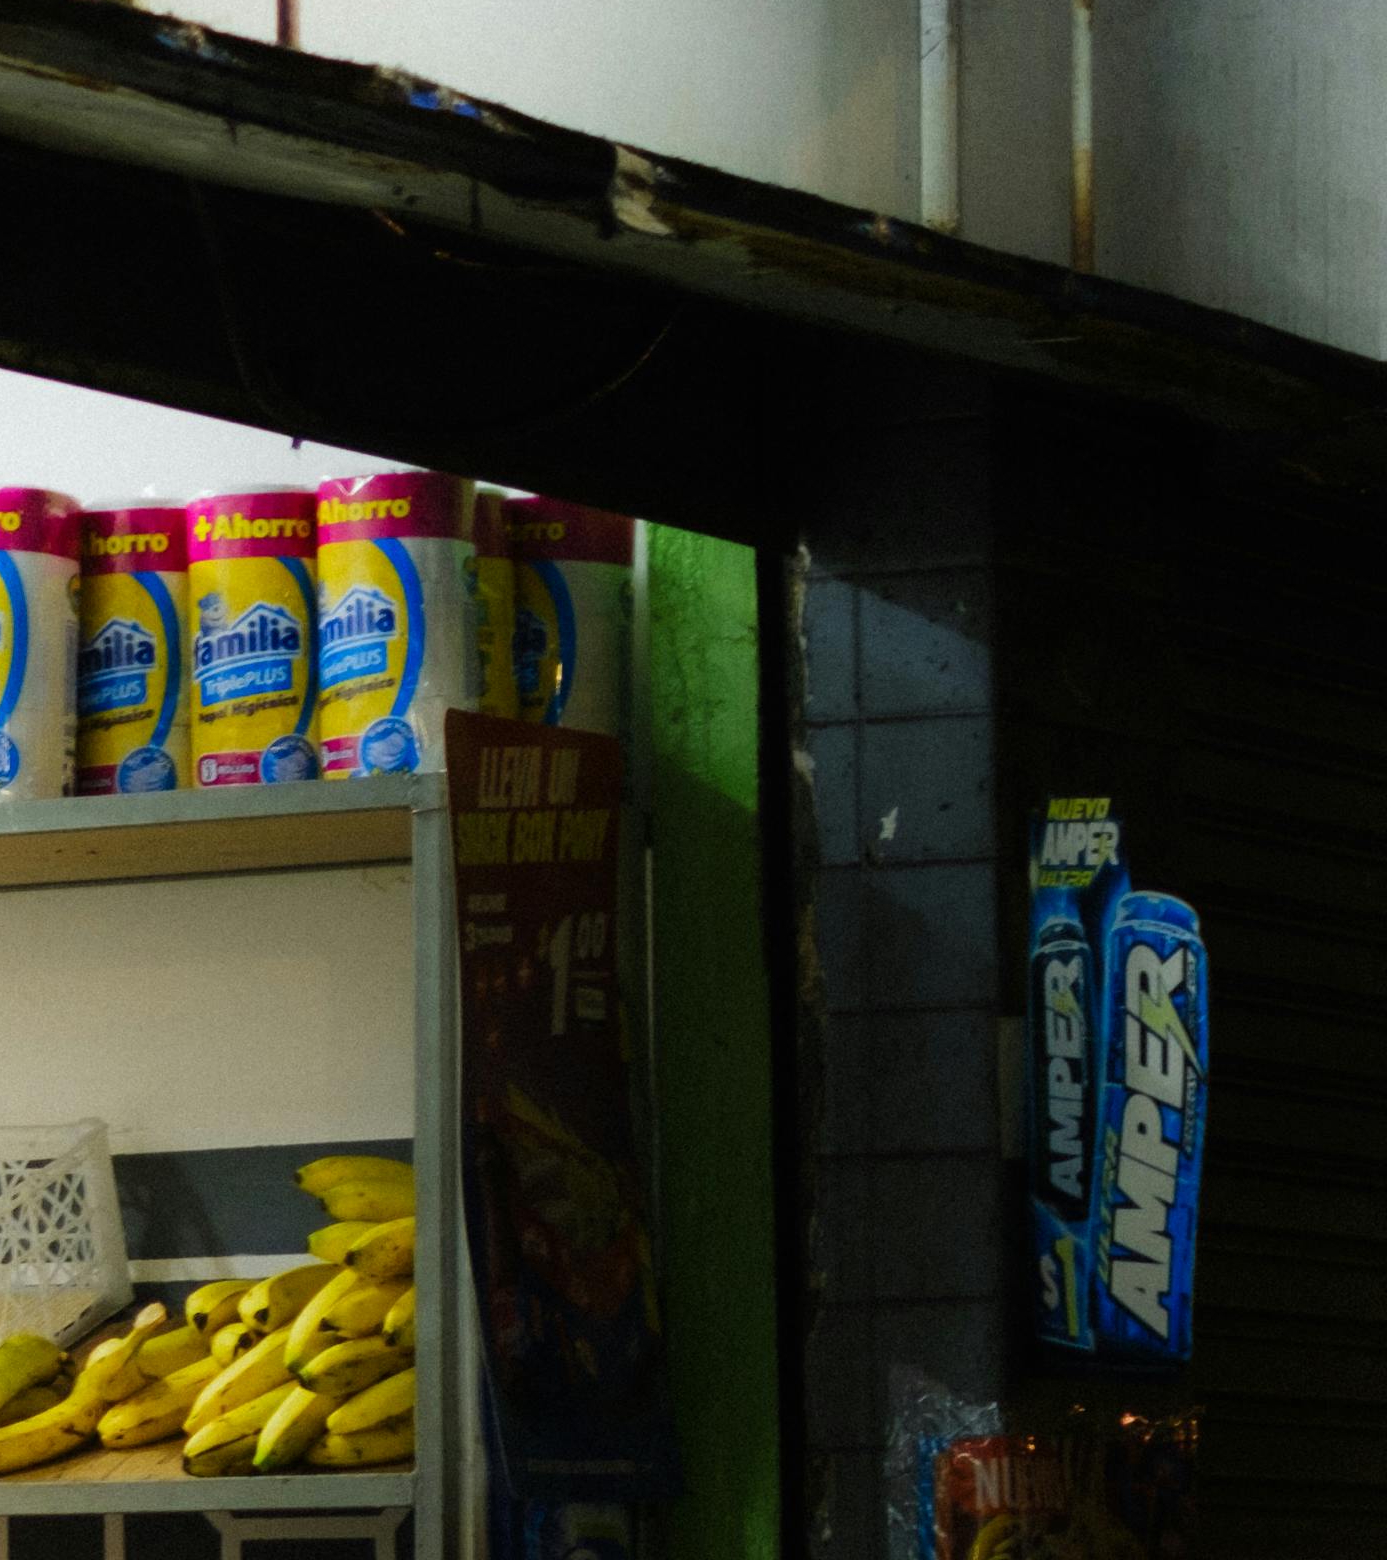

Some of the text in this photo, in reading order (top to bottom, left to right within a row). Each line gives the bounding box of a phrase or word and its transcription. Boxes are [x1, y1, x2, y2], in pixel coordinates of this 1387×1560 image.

[1041, 820, 1121, 867] AMPER
[1047, 797, 1111, 821] NUEVO
[1043, 953, 1086, 1200] AMPER
[1109, 943, 1188, 1341] AMPER
